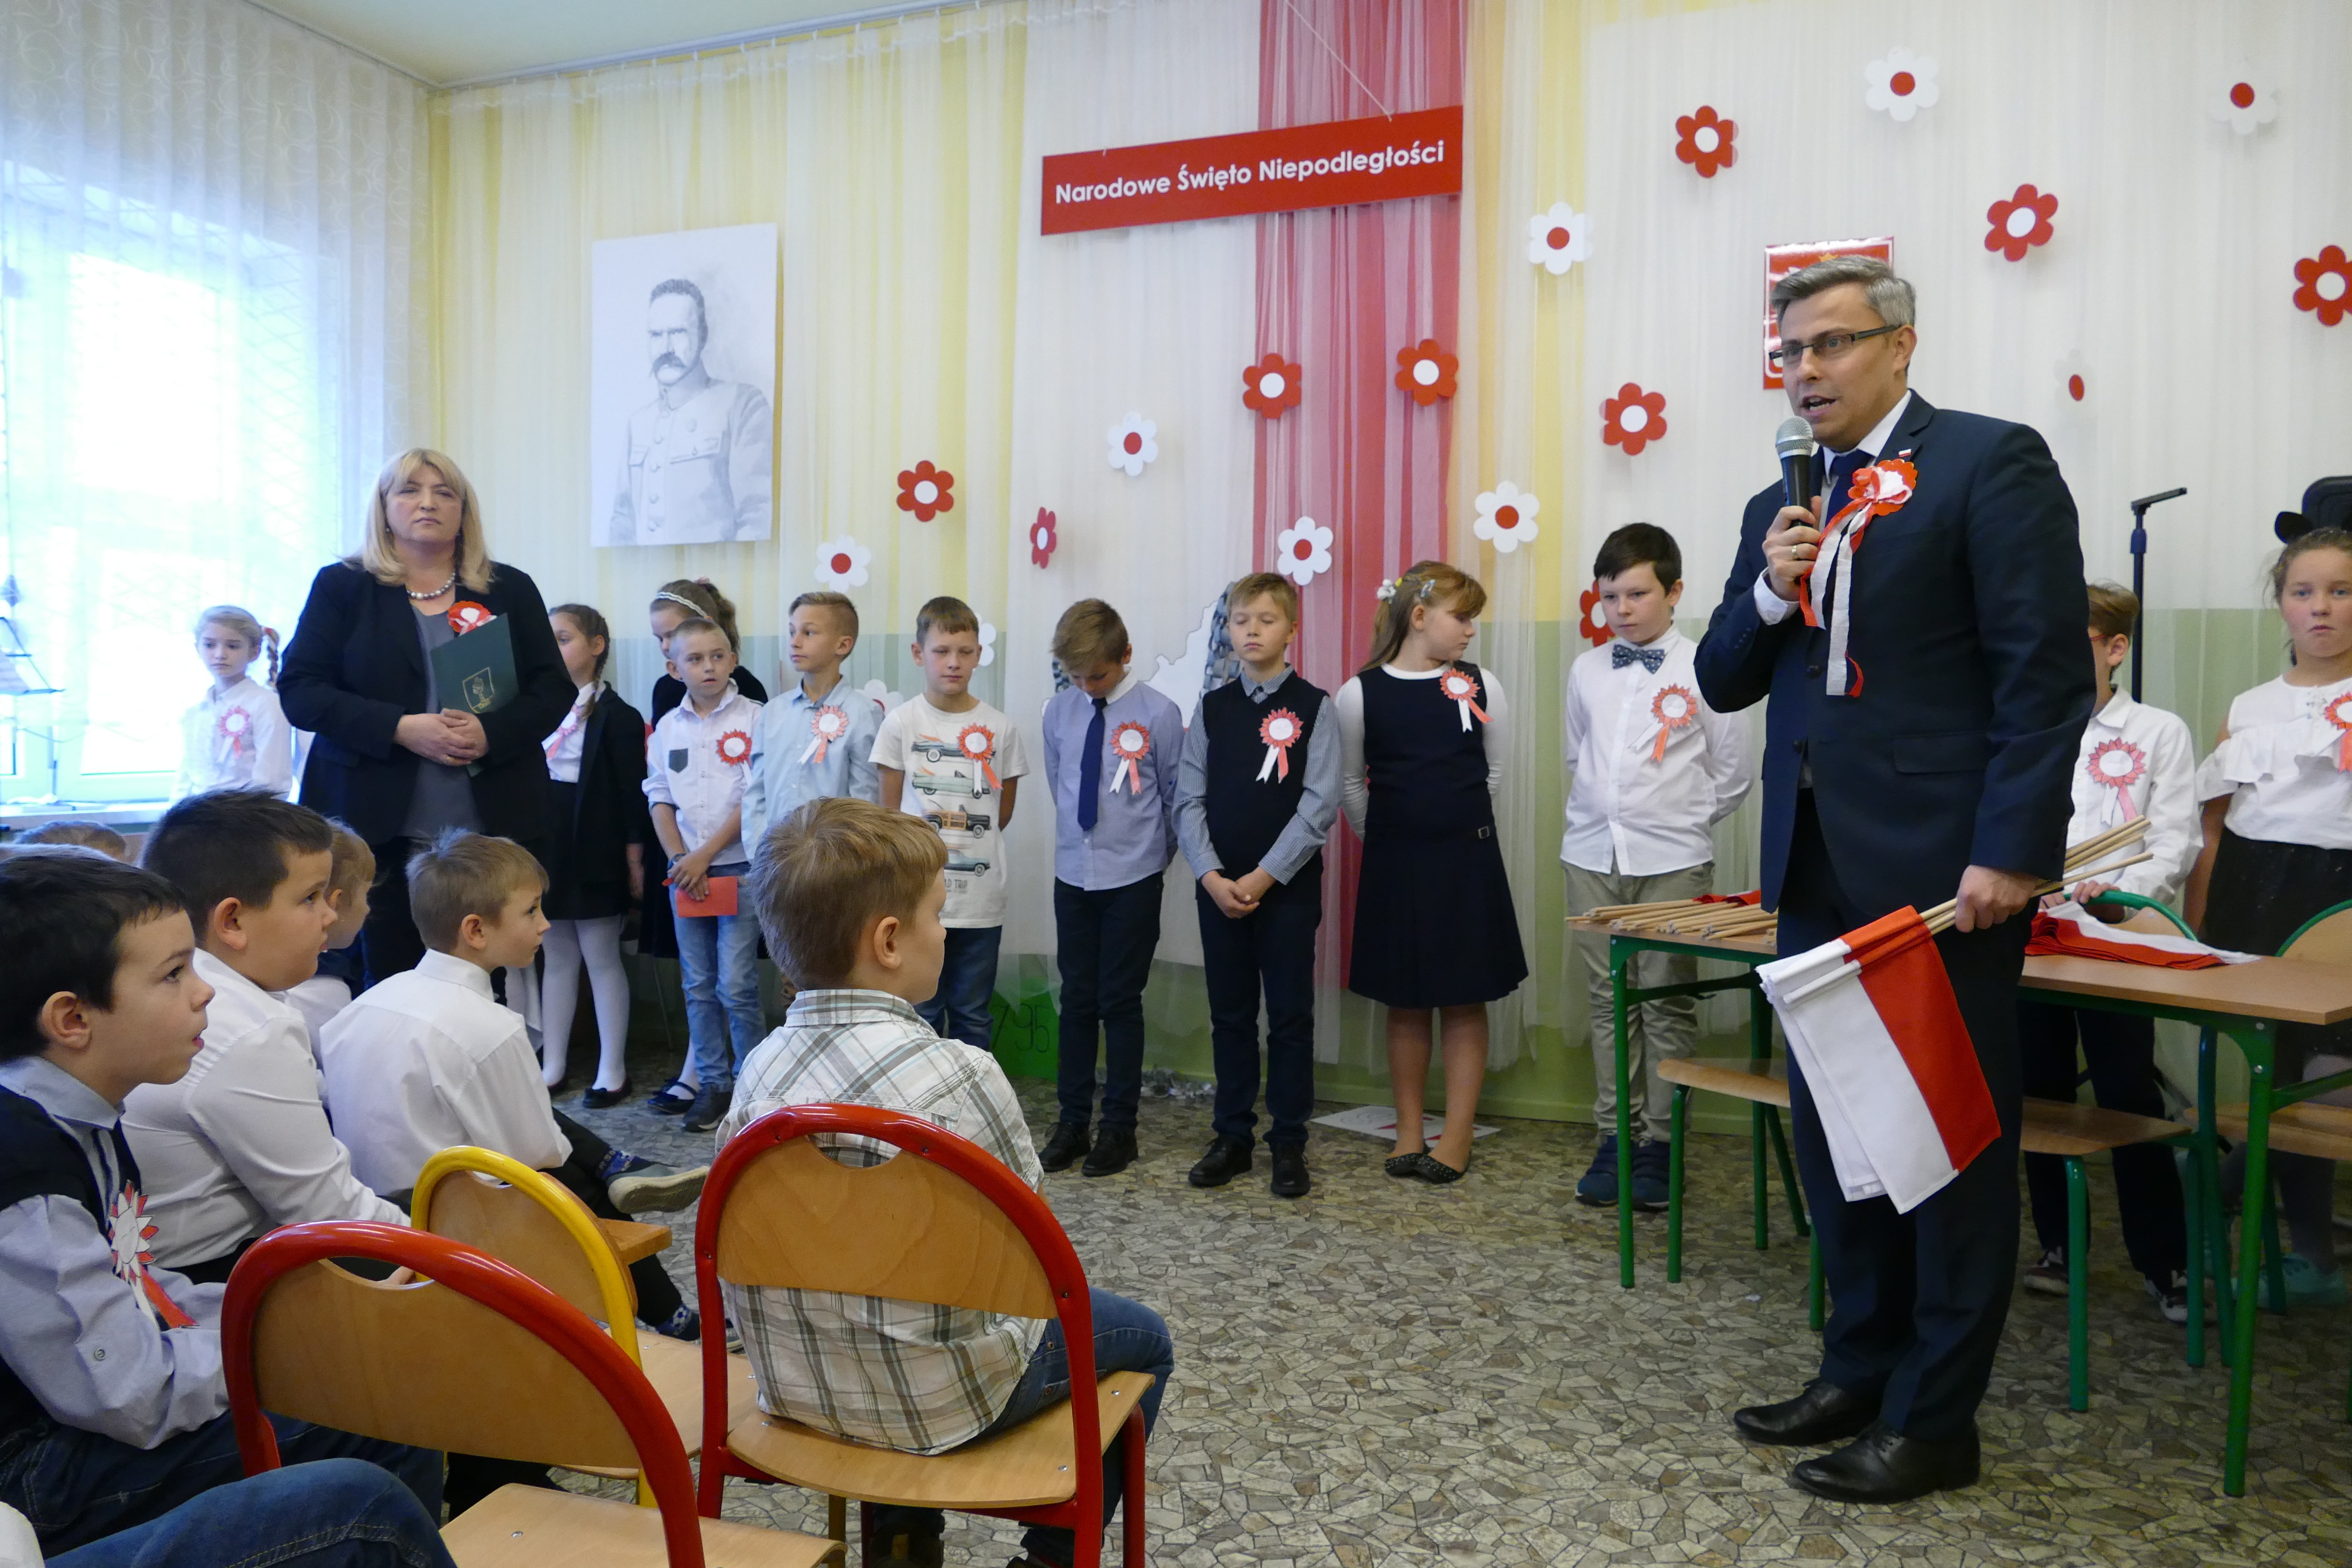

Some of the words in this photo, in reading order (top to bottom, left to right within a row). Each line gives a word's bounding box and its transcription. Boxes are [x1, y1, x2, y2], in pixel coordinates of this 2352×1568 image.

[1056, 177, 1171, 204] Narodowe
[1177, 163, 1252, 191] Święto
[1259, 140, 1445, 182] Niepodległości
